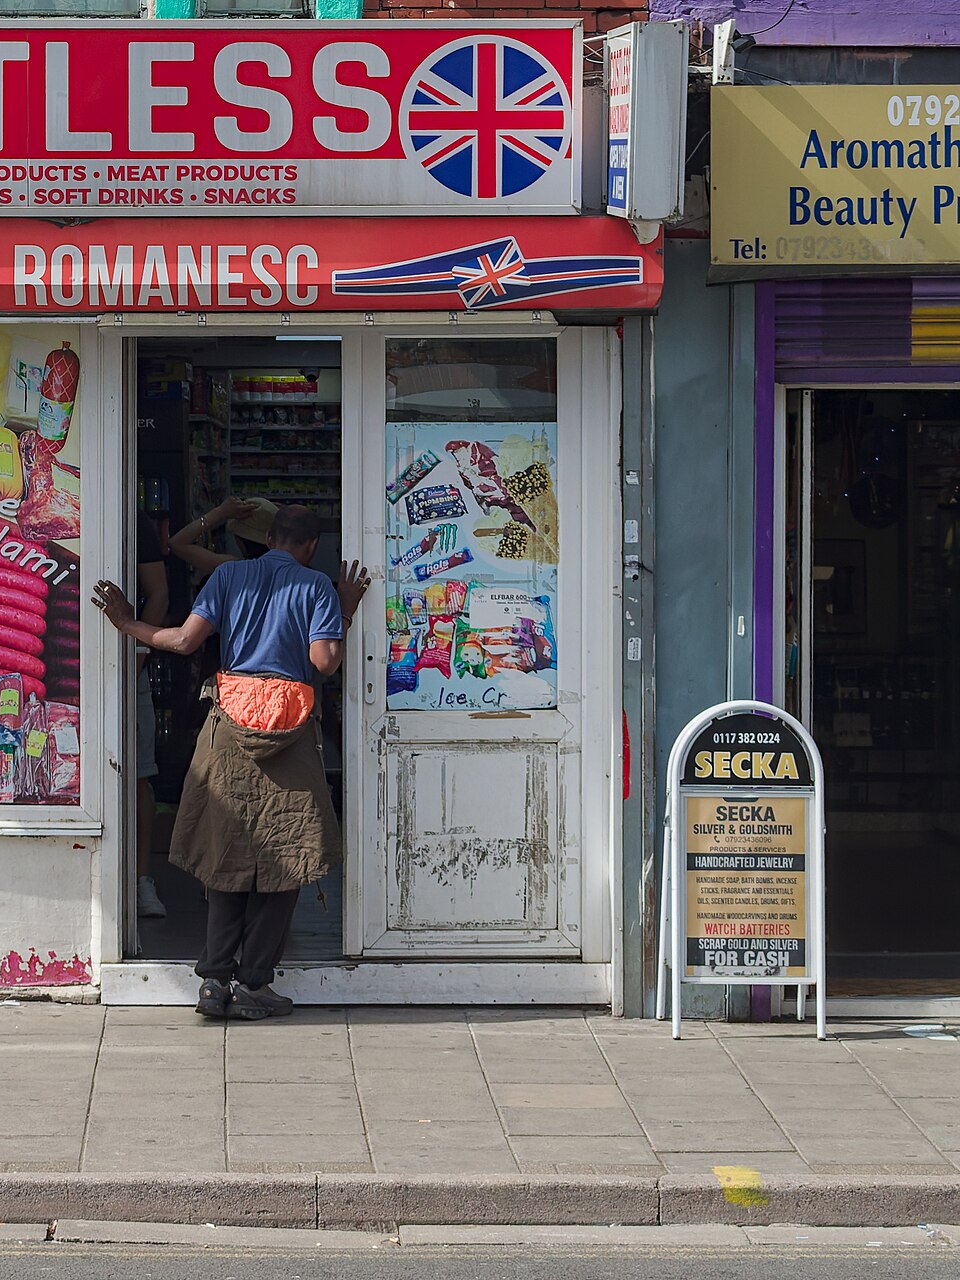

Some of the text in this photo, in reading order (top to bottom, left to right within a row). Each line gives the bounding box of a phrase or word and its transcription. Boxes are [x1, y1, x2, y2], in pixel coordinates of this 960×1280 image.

[887, 94, 960, 126] 0792
[107, 165, 170, 182] MEAT
[176, 165, 298, 182] PRODUCTS
[33, 188, 92, 205] SOFT
[98, 188, 184, 205] DRINKS
[204, 188, 297, 205] SNACKS
[789, 186, 917, 239] Beauty
[729, 237, 767, 260] Tel:
[14, 243, 320, 307] ROMANESC
[438, 687, 467, 705] Ice
[713, 733, 781, 744] 0117 382 0224
[694, 751, 800, 780] SECKA
[715, 805, 776, 822] SECKA
[693, 823, 793, 836] SILVER & GOLDSMITH
[695, 856, 794, 869] HANDCRAFTED JEWELRY
[696, 876, 725, 884] HANDMADE
[775, 877, 798, 885] INCENSE
[720, 887, 751, 895] FRAGRANCE
[696, 912, 726, 920] HANDMADE
[726, 912, 767, 920] WOODCARVINGS
[768, 912, 779, 920] AND
[704, 923, 790, 936] WATCH BATTERIES
[698, 938, 799, 951] SCRAP GOLD AND SILVER
[704, 950, 790, 967] FOR CASH
